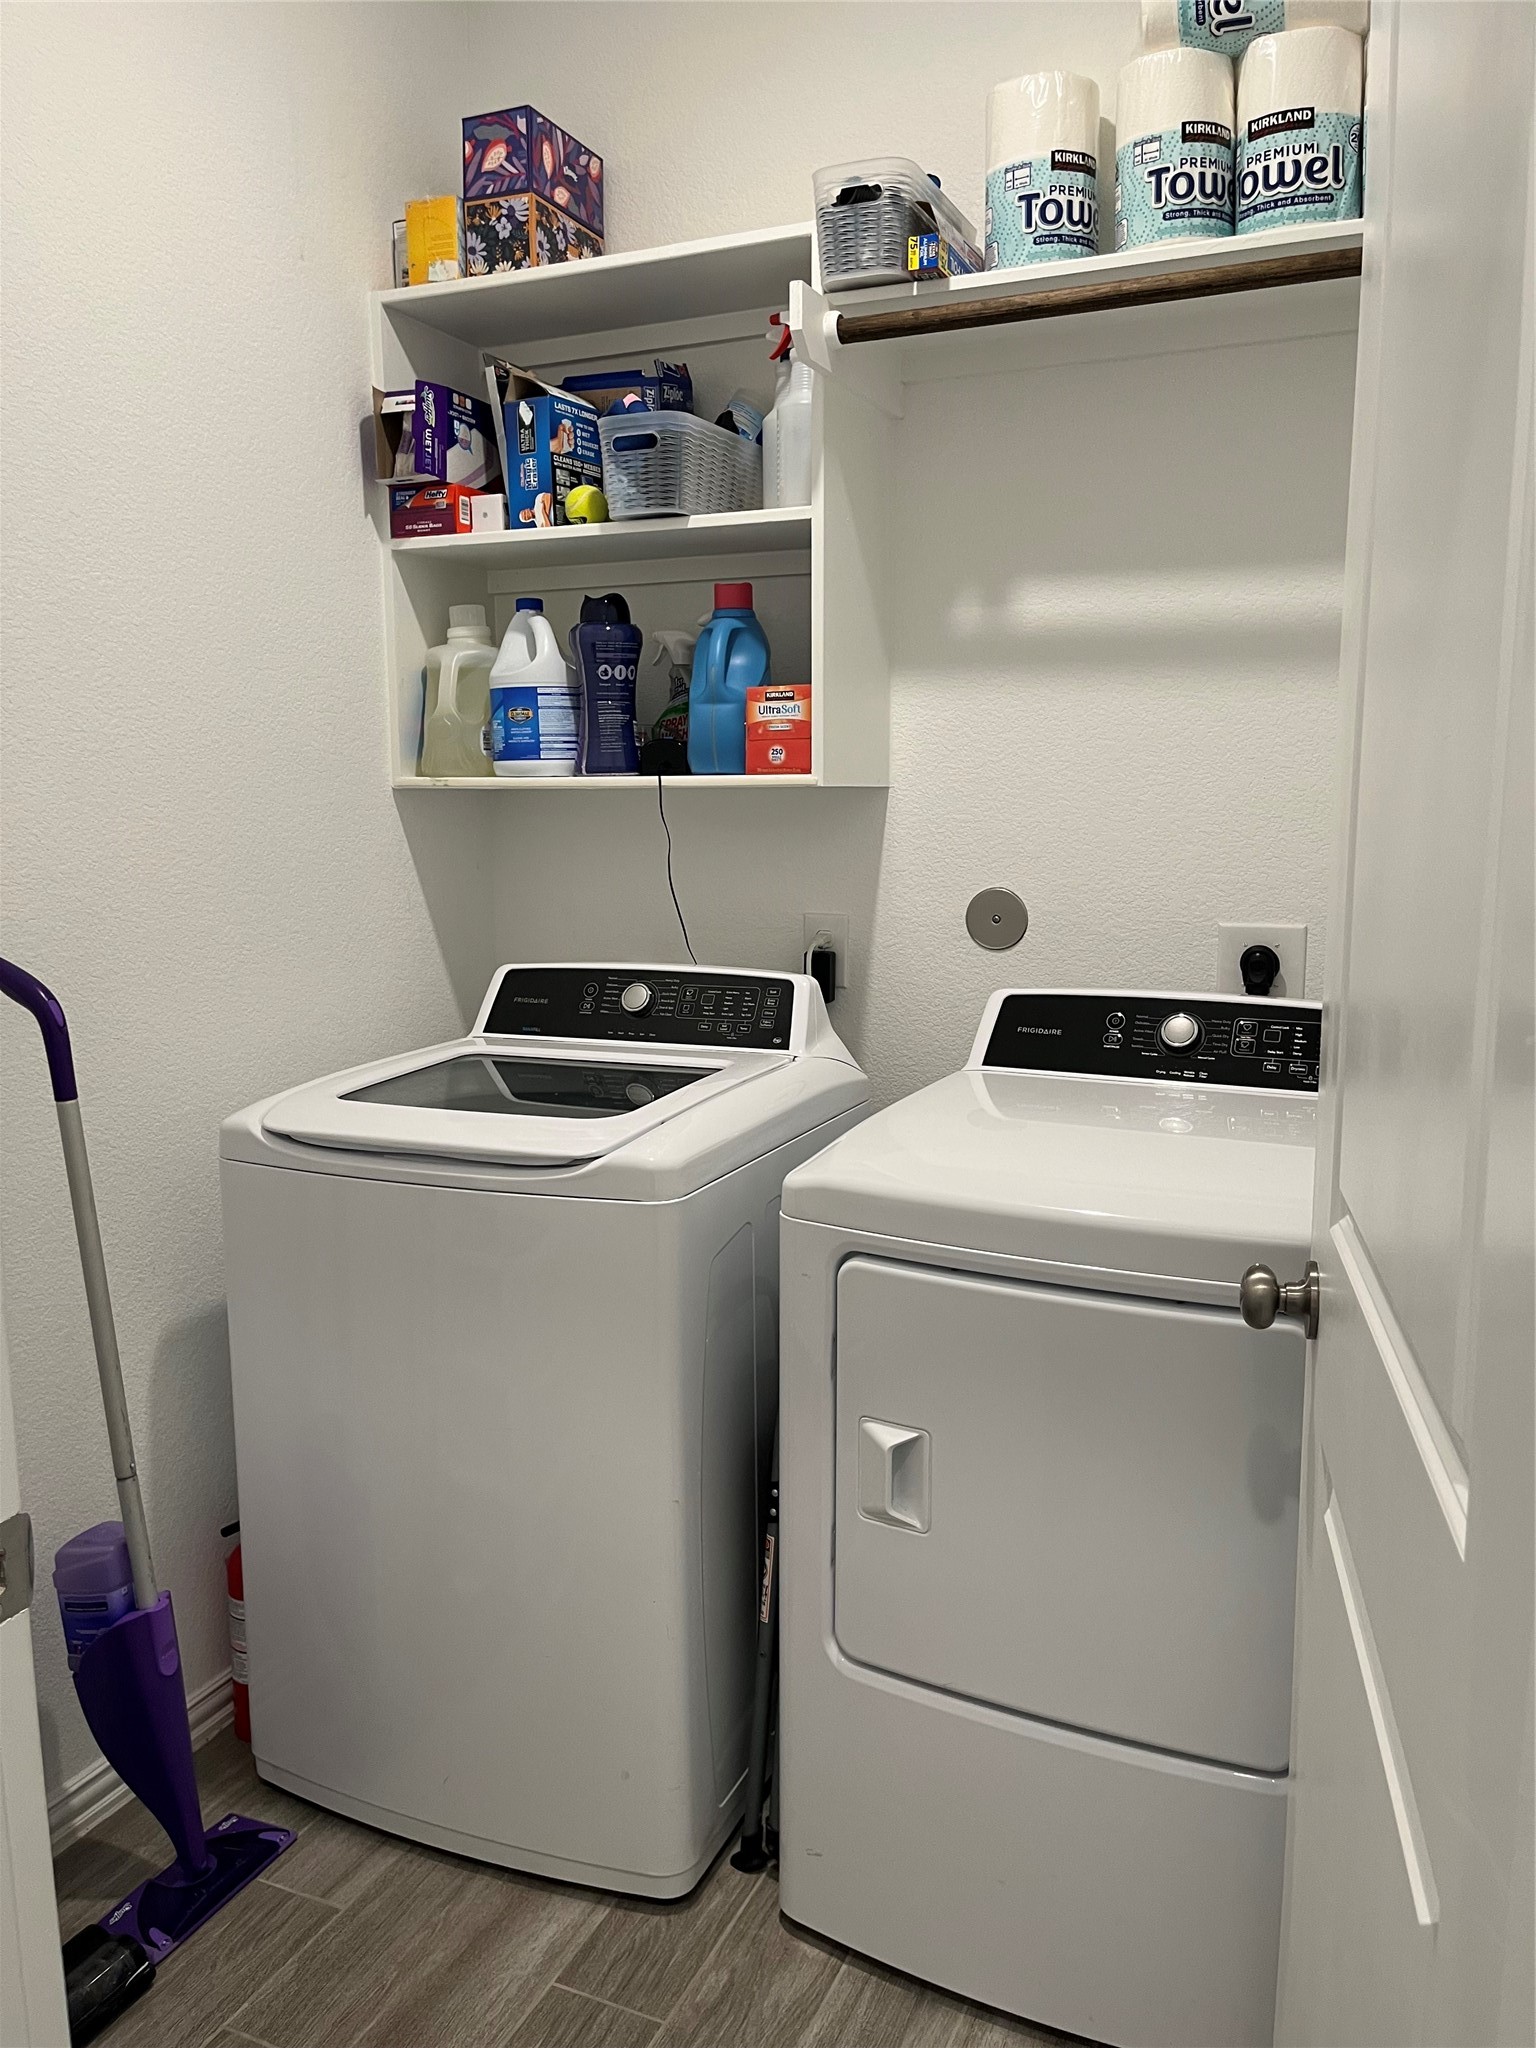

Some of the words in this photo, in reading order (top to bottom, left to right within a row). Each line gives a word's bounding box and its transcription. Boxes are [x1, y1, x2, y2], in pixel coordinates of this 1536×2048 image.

[1251, 109, 1312, 133] KIRKLAND
[1185, 123, 1230, 140] KIRKLAND
[1246, 143, 1319, 168] PREMIUM
[1239, 144, 1345, 205] owel
[1256, 200, 1275, 212] Thick
[1277, 196, 1291, 206] and
[1293, 194, 1332, 204] Absorbent
[910, 236, 918, 250] 75
[662, 385, 684, 404] Ziploc
[420, 385, 436, 427] Swiffer
[553, 454, 573, 465] CLEANS
[524, 458, 532, 490] Magic
[425, 489, 448, 499] Hefty
[758, 704, 801, 715] UltraSoft
[1016, 1026, 1063, 1036] FRIGIDAIRE
